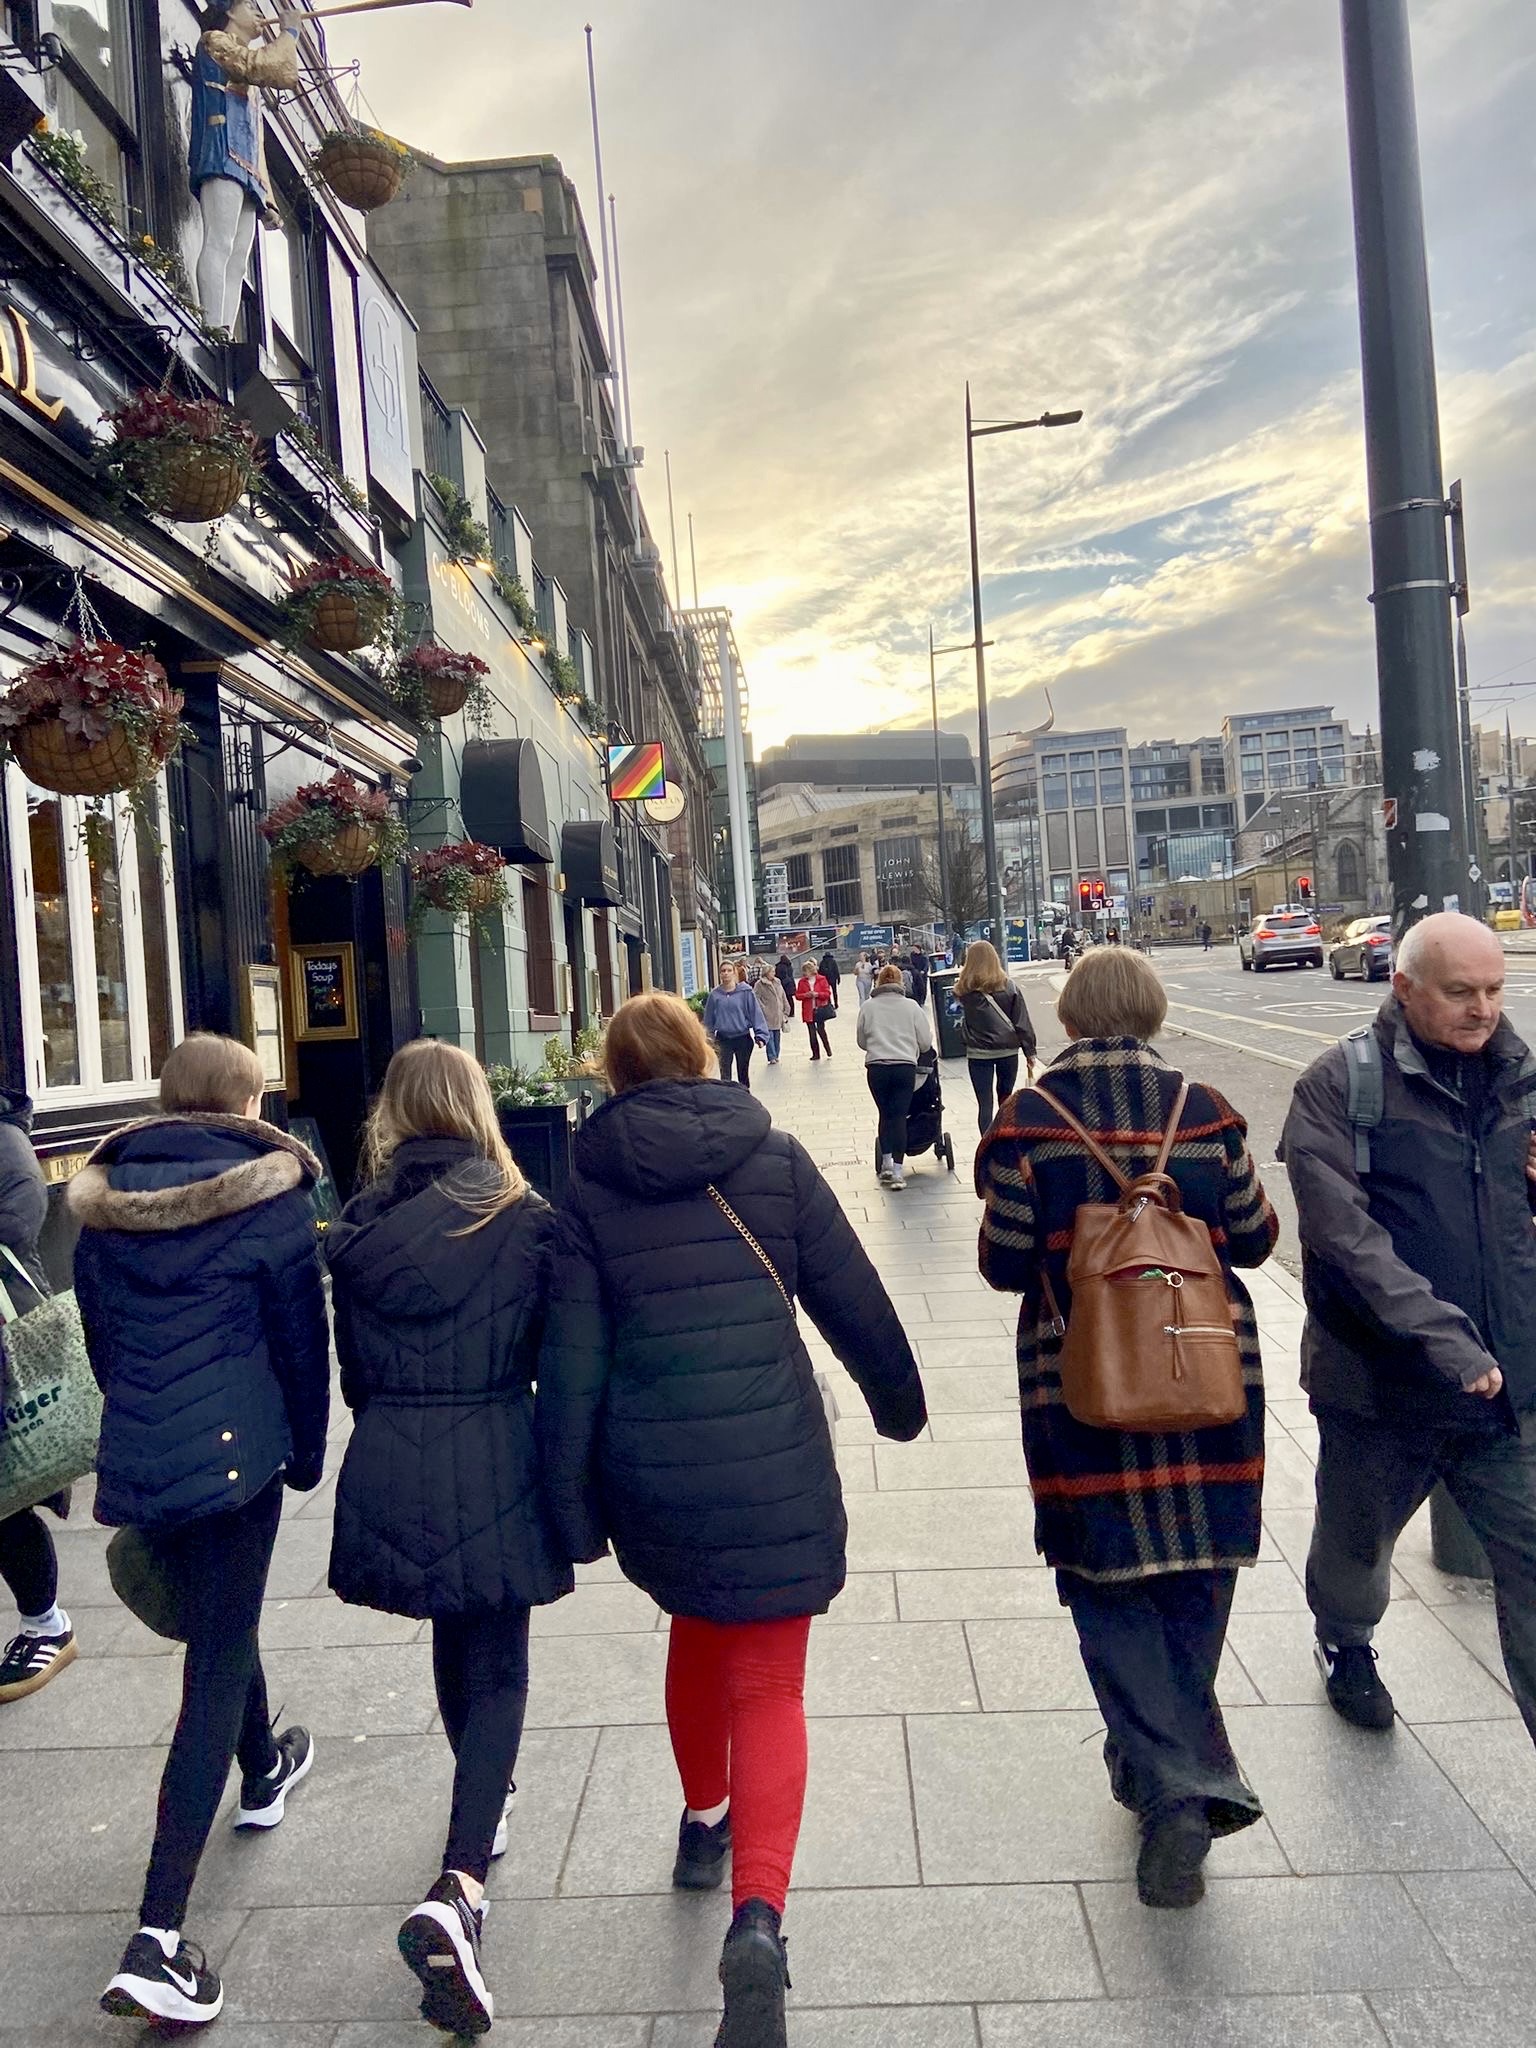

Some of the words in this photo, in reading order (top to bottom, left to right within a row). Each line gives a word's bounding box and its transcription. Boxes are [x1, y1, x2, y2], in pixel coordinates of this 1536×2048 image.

[450, 572, 490, 641] BLOOMS
[884, 857, 911, 867] JOHN
[882, 869, 914, 880] LEWIS
[311, 971, 334, 984] Soup
